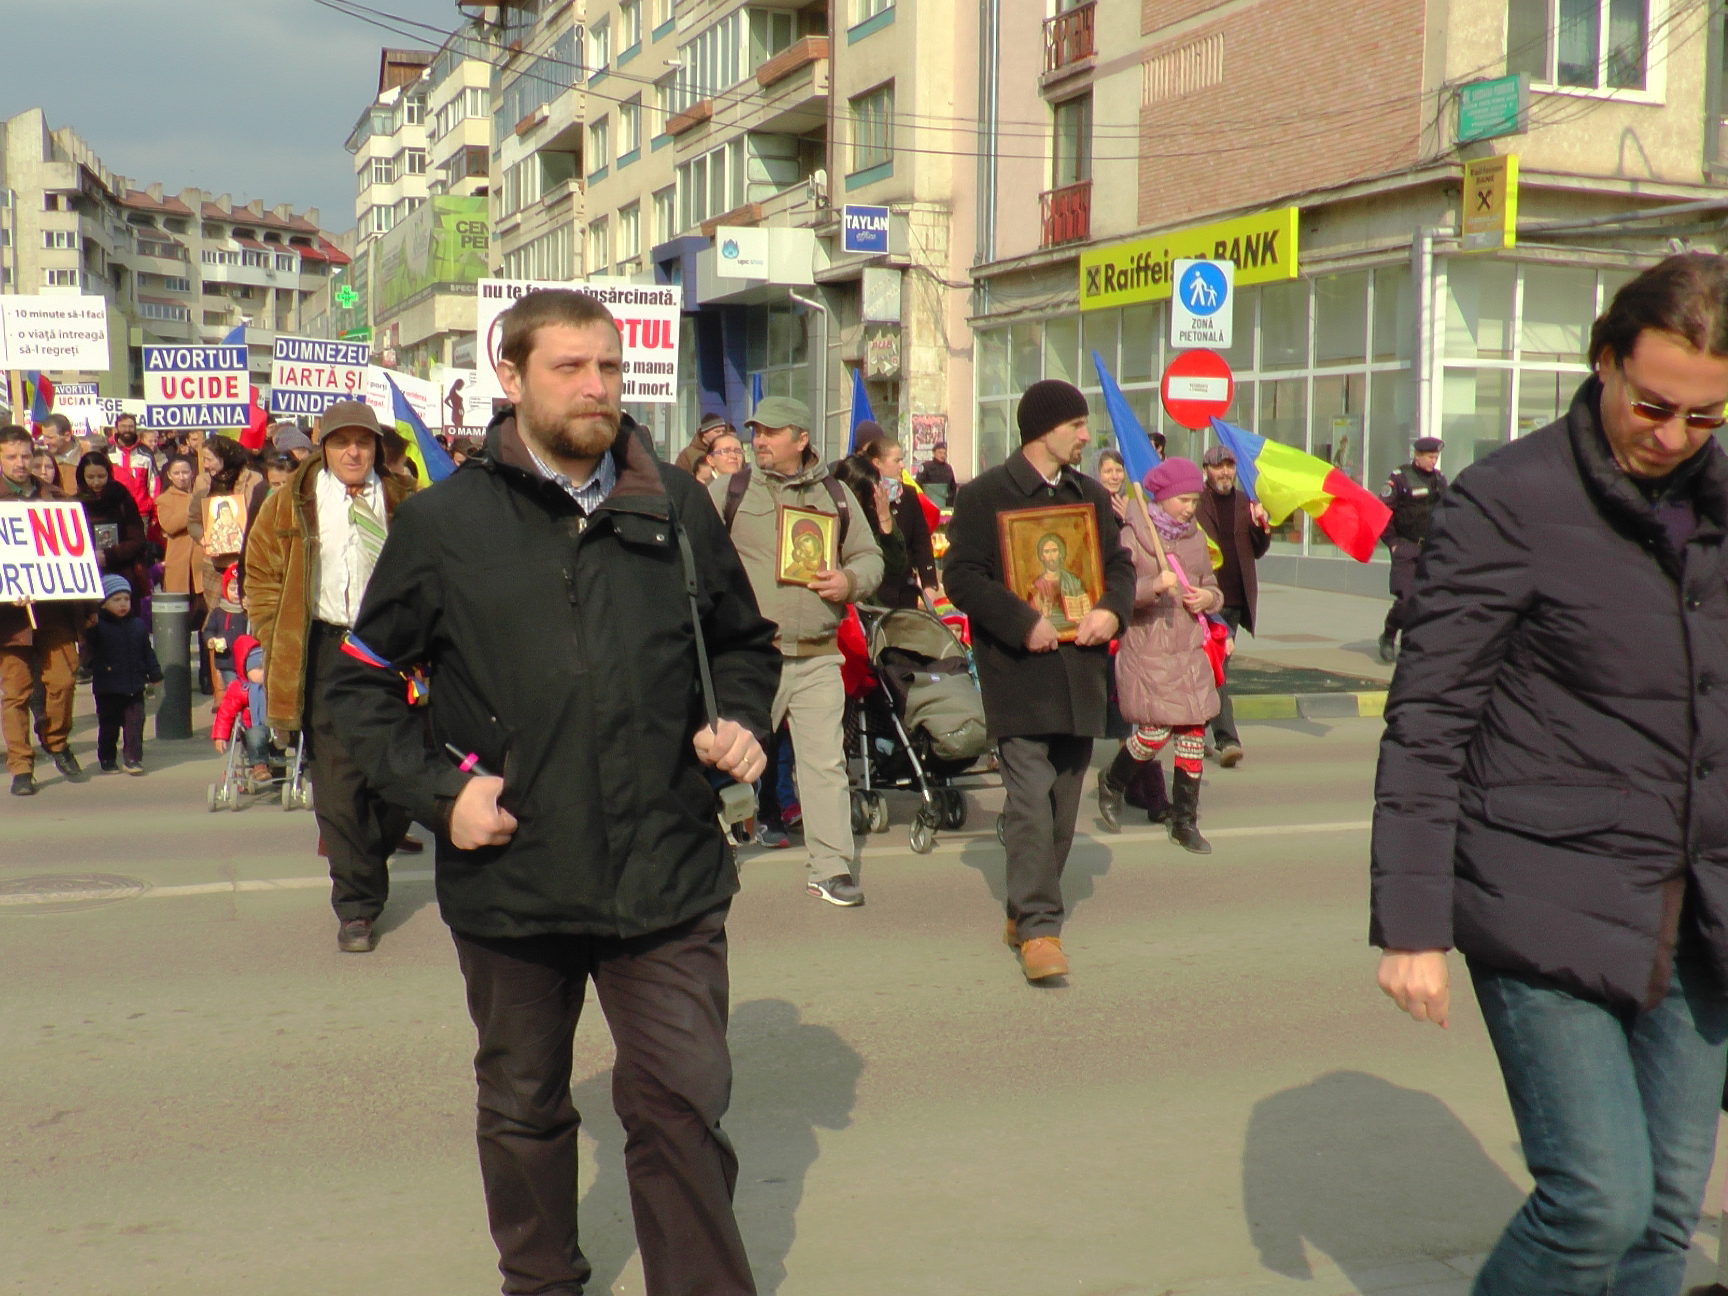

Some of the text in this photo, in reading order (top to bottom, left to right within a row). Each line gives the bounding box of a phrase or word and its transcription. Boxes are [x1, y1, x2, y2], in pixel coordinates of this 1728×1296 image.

[845, 214, 888, 231] TAYLAN
[483, 284, 503, 299] nu
[506, 284, 523, 300] te
[15, 309, 28, 318] 10
[29, 309, 66, 319] minute
[86, 309, 105, 319] faci
[18, 331, 26, 339] o
[149, 349, 244, 369] AVORTUL
[275, 339, 369, 365] DUMNEZEU
[279, 363, 339, 388] IARTĂ
[633, 361, 675, 375] mama
[55, 384, 95, 395] AVORTUL
[161, 375, 239, 400] UCIDE
[638, 380, 674, 396] mort.
[277, 392, 358, 412] VINDE
[152, 403, 246, 426] ROMÂNIA
[447, 426, 457, 436] O
[27, 507, 86, 557] NU
[0, 562, 97, 596] RTULUI
